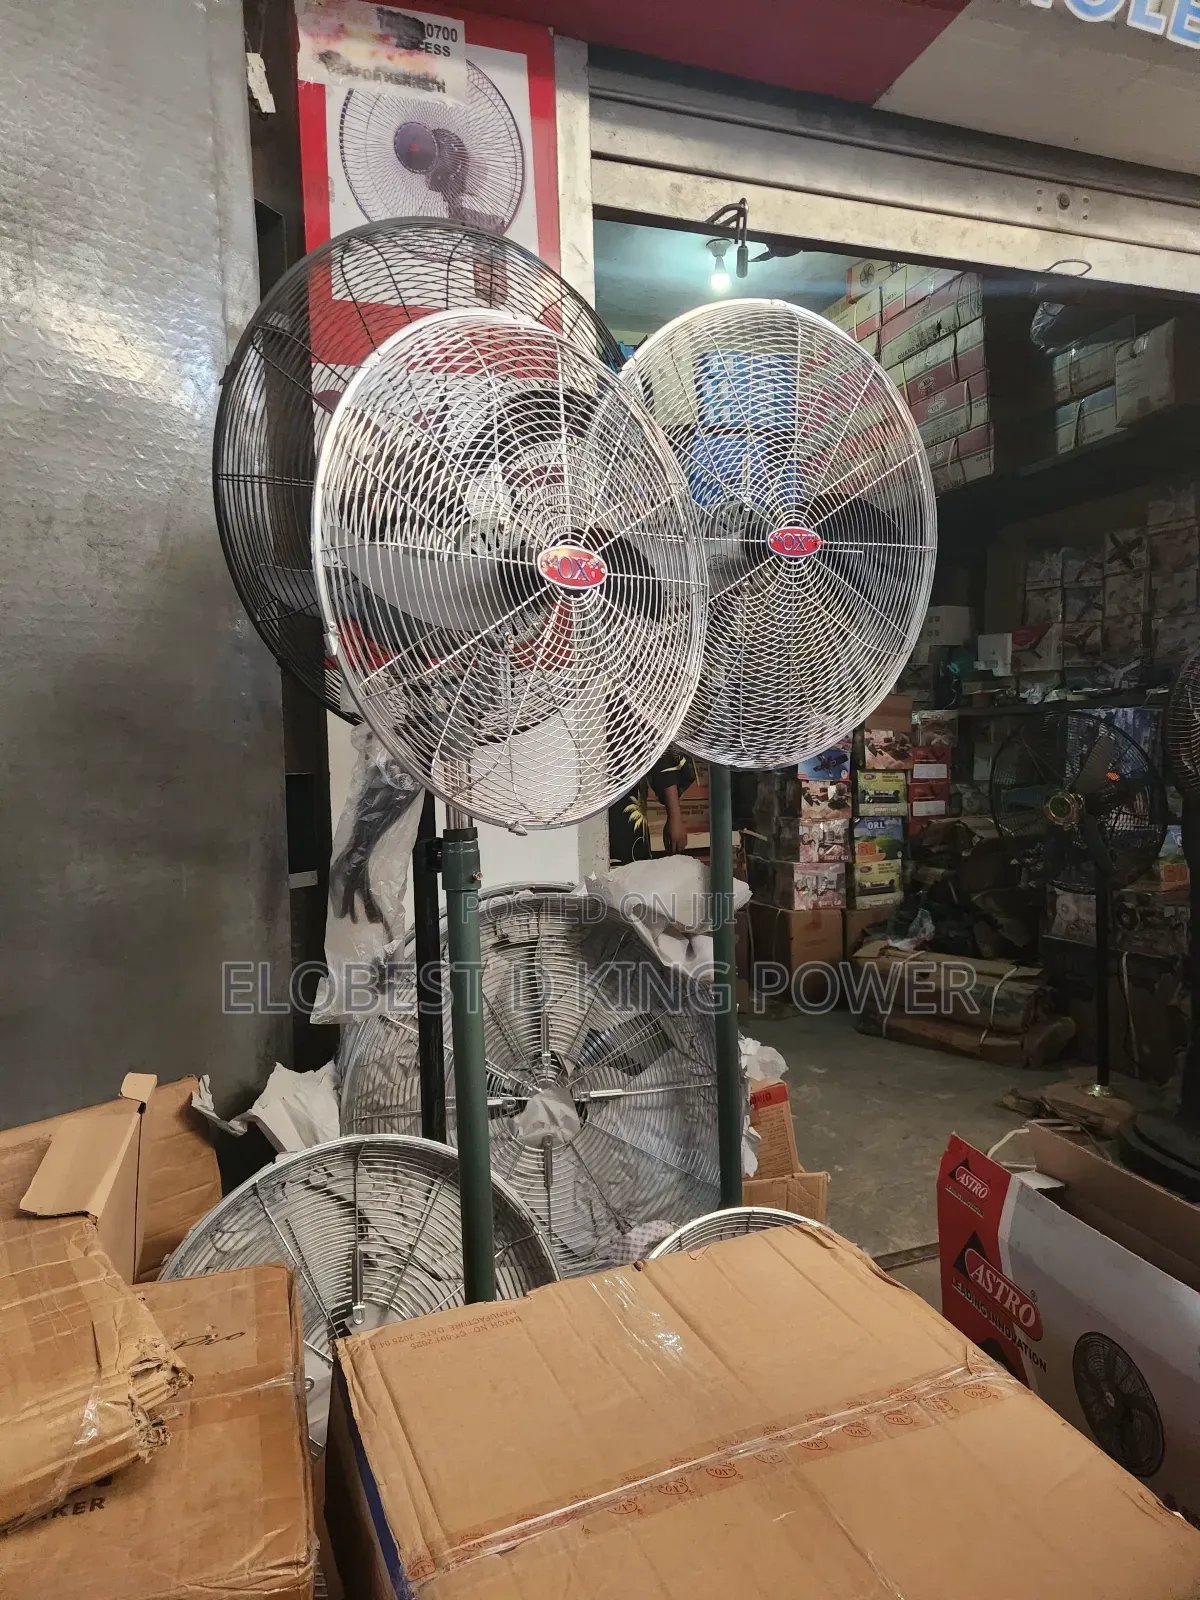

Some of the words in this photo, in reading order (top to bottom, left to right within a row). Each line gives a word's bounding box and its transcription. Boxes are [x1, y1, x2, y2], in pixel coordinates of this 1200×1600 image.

[424, 23, 458, 43] 0700
[957, 1173, 988, 1199] ASTRO
[969, 1263, 1036, 1328] ASTRO
[450, 1308, 517, 1331] MANUFACTURE
[473, 1325, 488, 1333] NO
[490, 1315, 523, 1330] BATCH
[952, 1276, 988, 1319] LEADING
[988, 1313, 1047, 1373] INNOVATION
[392, 1332, 415, 1345] 2025
[420, 1326, 445, 1339] DATE
[410, 1337, 434, 1349] 2025
[41, 1497, 106, 1520] KER
